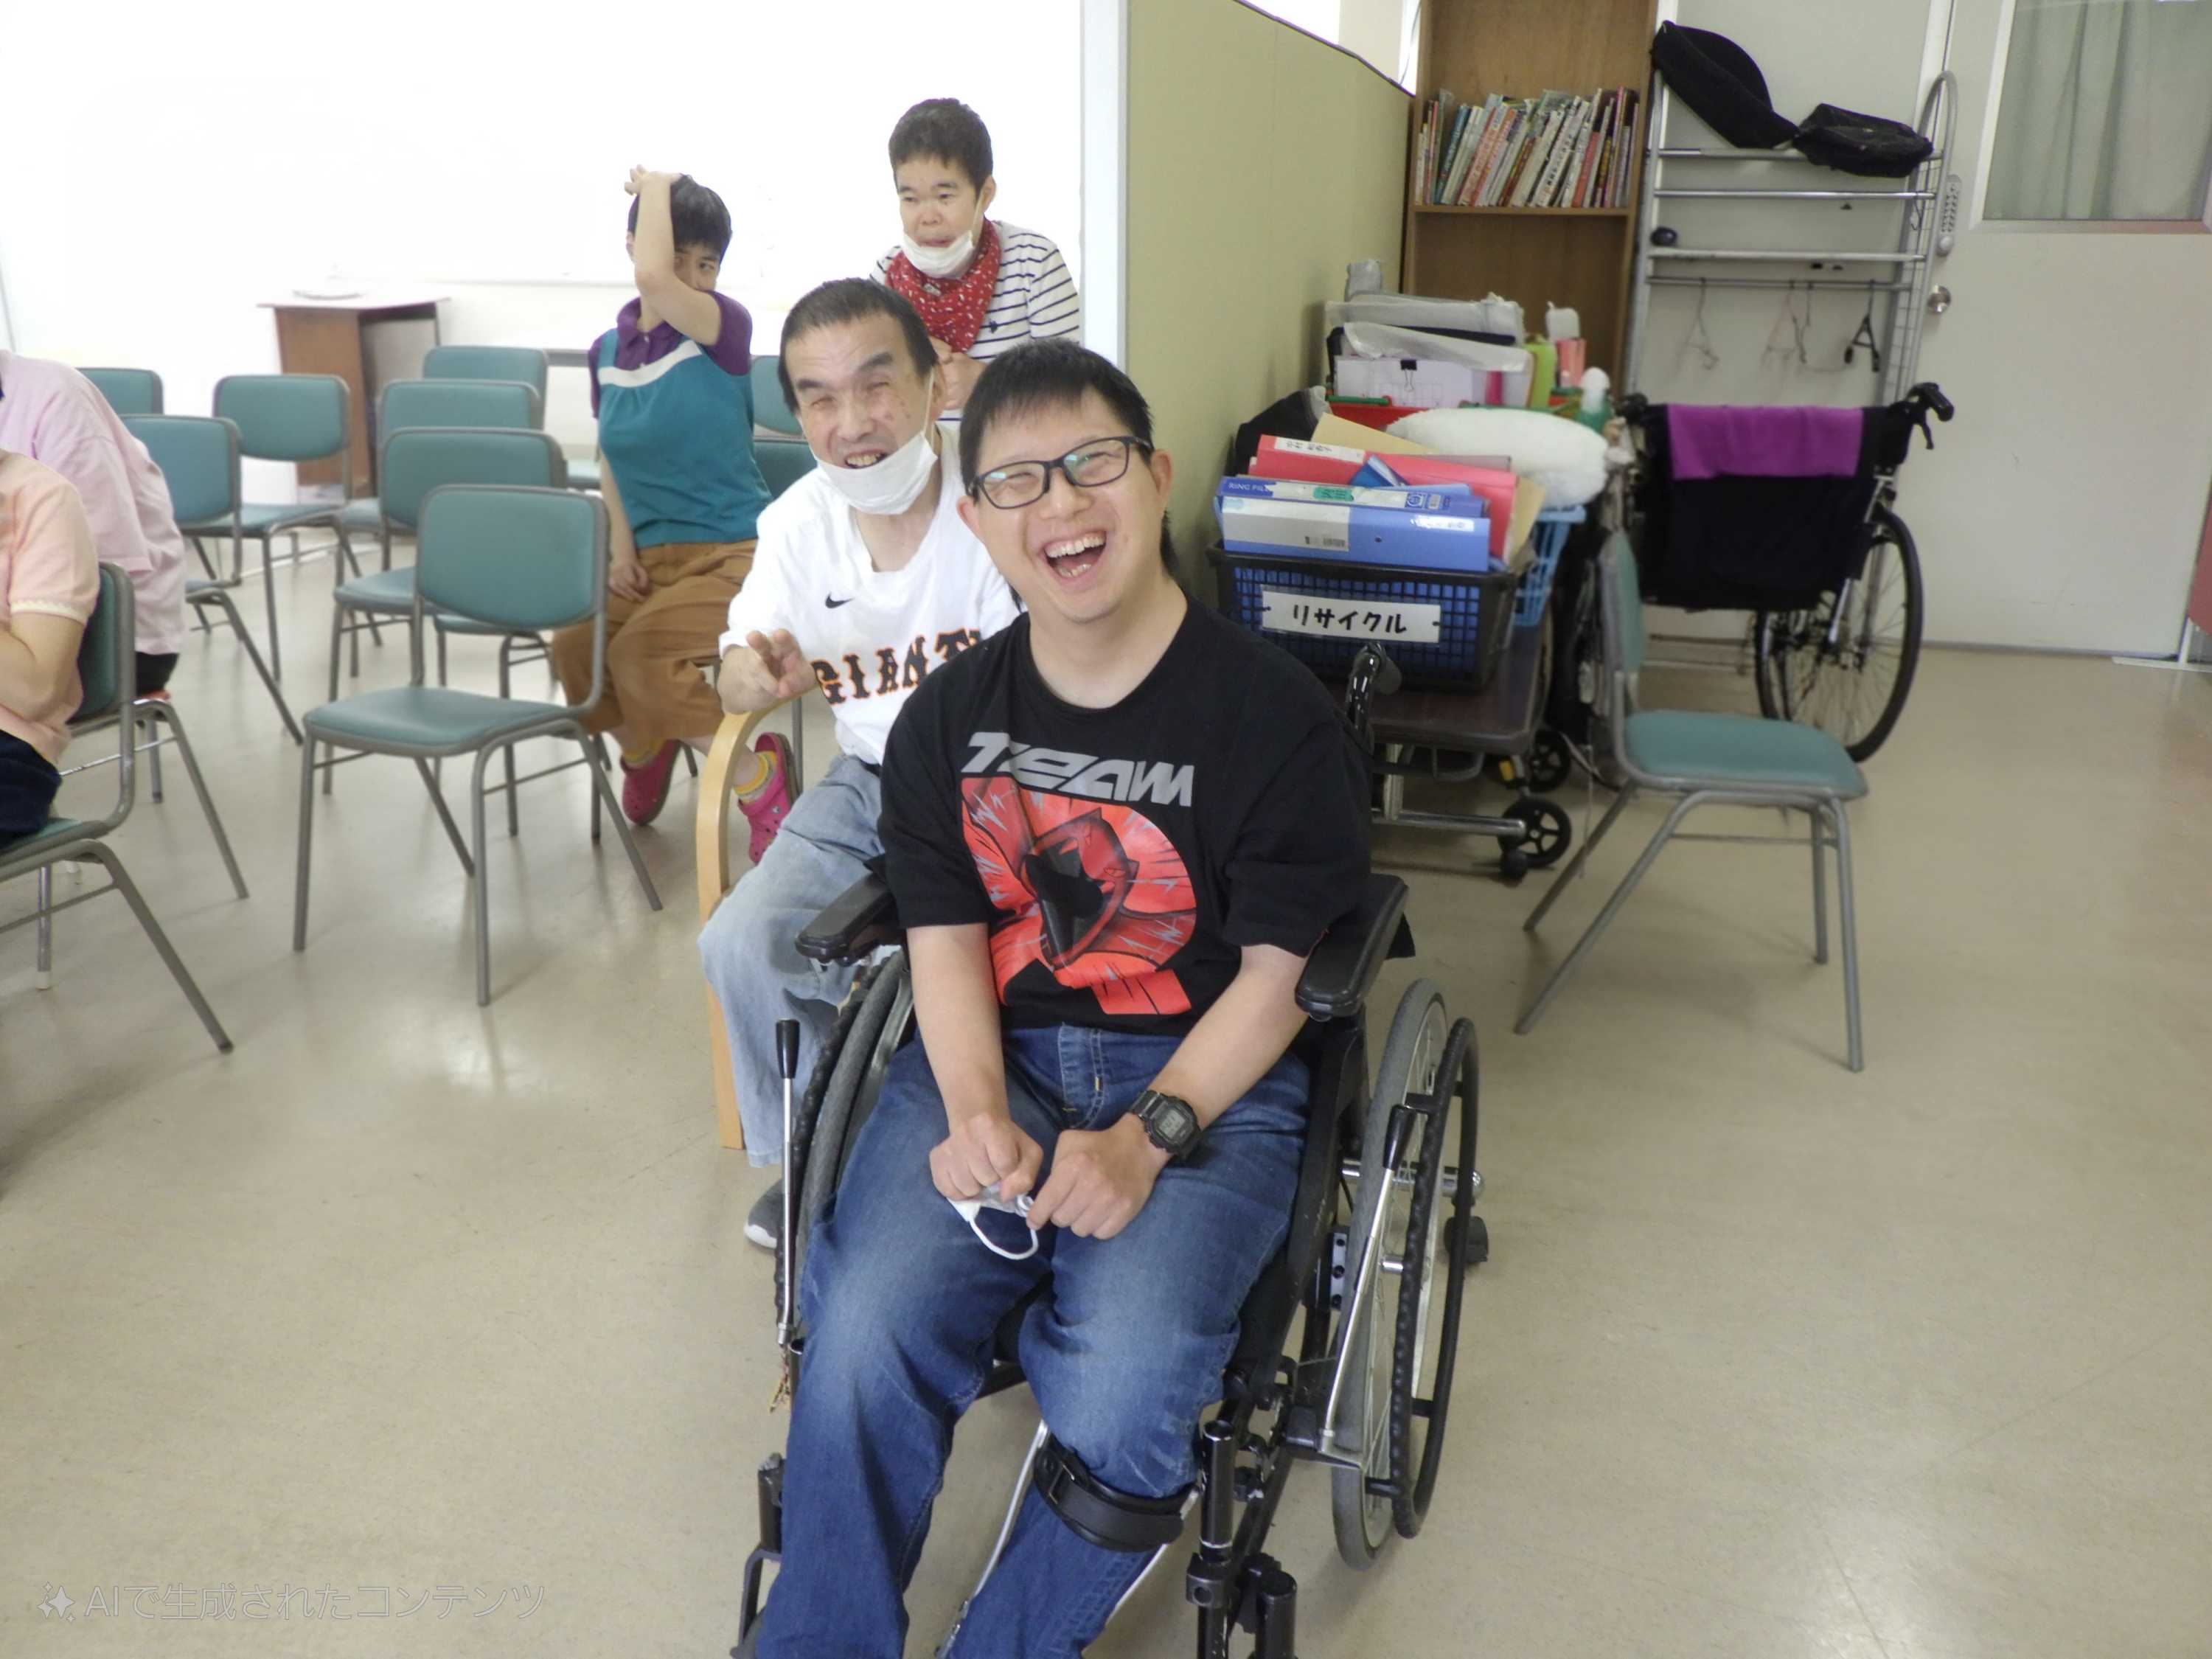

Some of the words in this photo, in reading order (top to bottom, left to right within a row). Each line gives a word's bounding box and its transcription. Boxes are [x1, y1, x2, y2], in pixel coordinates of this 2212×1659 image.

[1293, 604, 1407, 634] リサイクル
[811, 627, 981, 705] GIANT
[960, 731, 1195, 807] TEAM
